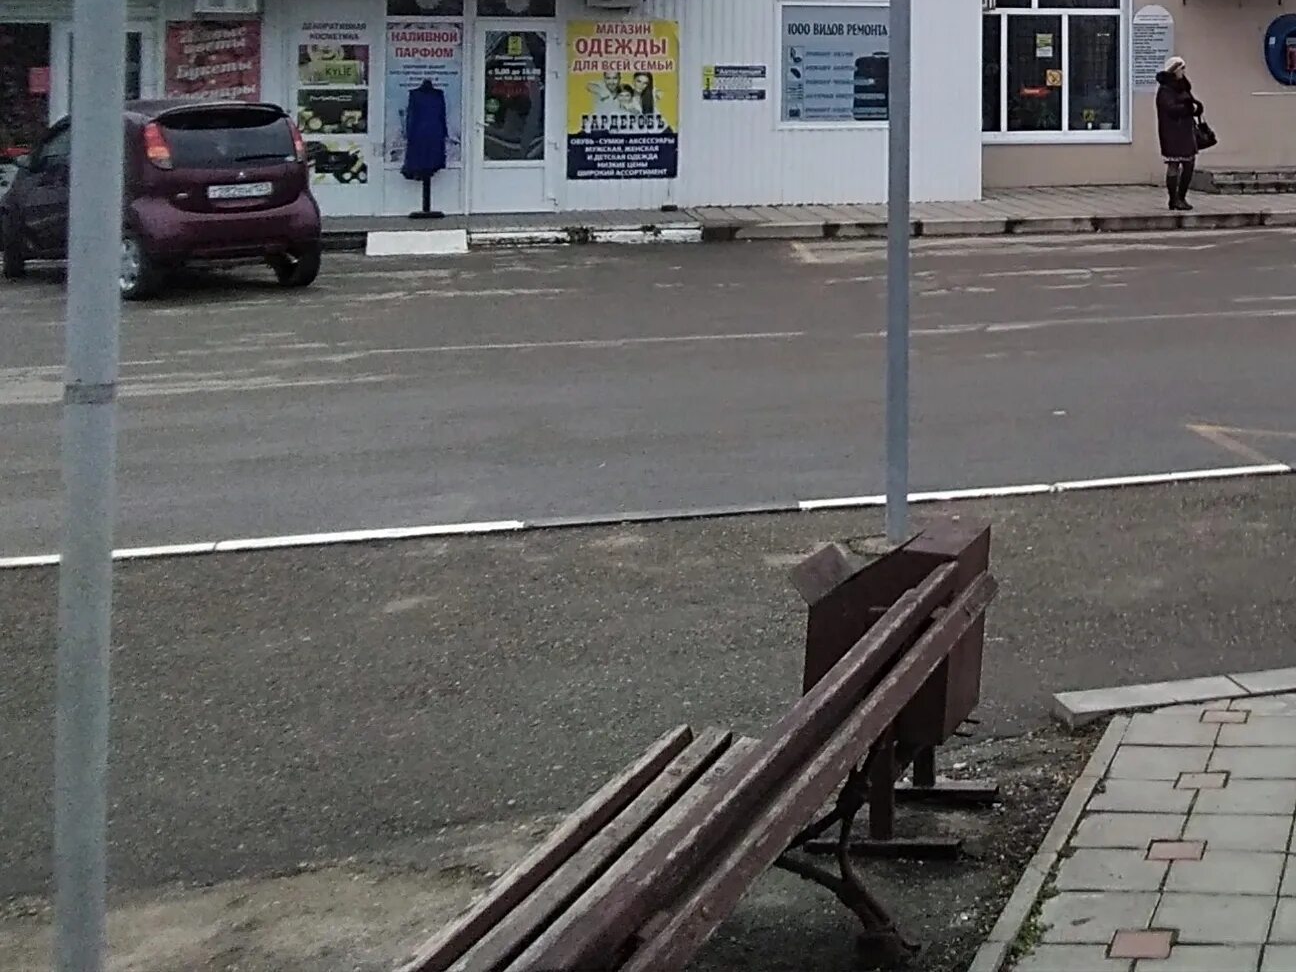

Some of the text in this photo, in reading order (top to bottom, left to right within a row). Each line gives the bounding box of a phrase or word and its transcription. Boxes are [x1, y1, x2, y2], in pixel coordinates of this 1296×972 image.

[301, 21, 367, 31] ДЕКОРАТИВНАЯ
[595, 23, 652, 35] МАГАЗИН
[787, 22, 888, 37] 1000 ВИДОВ РЕМОНТА
[309, 32, 360, 41] КОСМЕТИКА
[391, 31, 459, 43] НАЛИВНОЙ
[395, 46, 454, 59] ПАРФЮМ
[575, 38, 667, 58] ОДЕЖДЫ
[325, 66, 353, 77] KYLIE
[572, 60, 674, 72] ДЛЯ ВСЕЙ СЕМЬИ
[581, 113, 666, 131] ГАРДЕРОБЪ
[570, 137, 595, 146] ОБУВЬ
[628, 136, 676, 146] АКСЕССУАРЫ
[625, 145, 660, 154] ЖЕНСКАЯ
[587, 153, 659, 163] И ДЕТСКАЯ ОДЕЖДА
[596, 162, 649, 171] НИЗКИЕ ЦЕНЫ
[576, 168, 668, 178] ШИРОКИЙ АССОРТИМЕНТ
